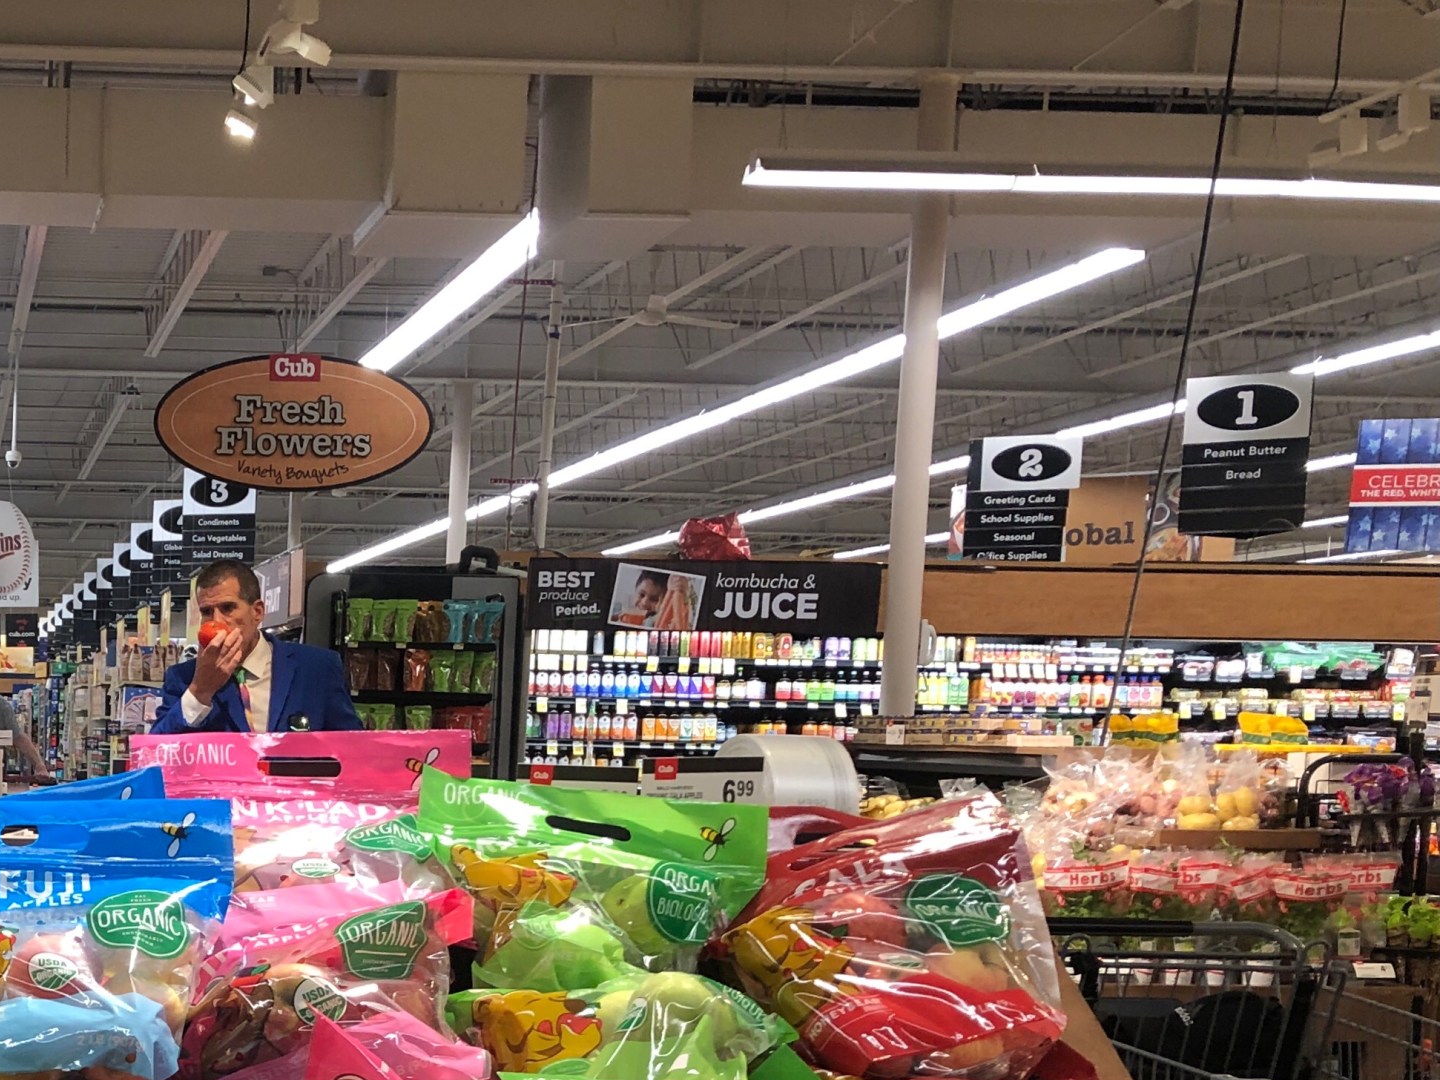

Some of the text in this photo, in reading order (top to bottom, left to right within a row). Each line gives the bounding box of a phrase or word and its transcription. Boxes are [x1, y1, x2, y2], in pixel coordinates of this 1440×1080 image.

[274, 358, 315, 378] Cub
[234, 394, 345, 425] Fresh
[1235, 390, 1258, 426] 1
[216, 427, 372, 456] Flowers
[1204, 444, 1288, 459] Peanut Butter
[1018, 448, 1043, 478] 2
[237, 460, 350, 484] Variety Bouquets
[1225, 468, 1261, 480] Bread
[212, 482, 228, 503] 3
[984, 494, 1056, 506] Greeting Cards
[1360, 490, 1406, 498] THE RED,
[198, 518, 240, 526] Condiments
[980, 514, 1054, 524] School Supplies
[192, 534, 246, 543] Can Vegetables
[993, 532, 1035, 541] Seasonal
[192, 550, 244, 560] Salad Dressing
[1008, 551, 1048, 561] Supplies
[538, 571, 596, 588] BEST
[716, 572, 816, 590] kombucha &
[10, 595, 22, 603] up.
[539, 588, 590, 602] produce
[555, 603, 600, 617] Period.
[714, 592, 819, 620] JUICE
[155, 744, 236, 766] ORGANIC
[1070, 872, 1116, 886] Herbs
[1295, 881, 1342, 896] Herbs
[97, 907, 182, 936] ORGANIC
[344, 920, 419, 950] ORGANIC
[37, 957, 68, 968] USDA
